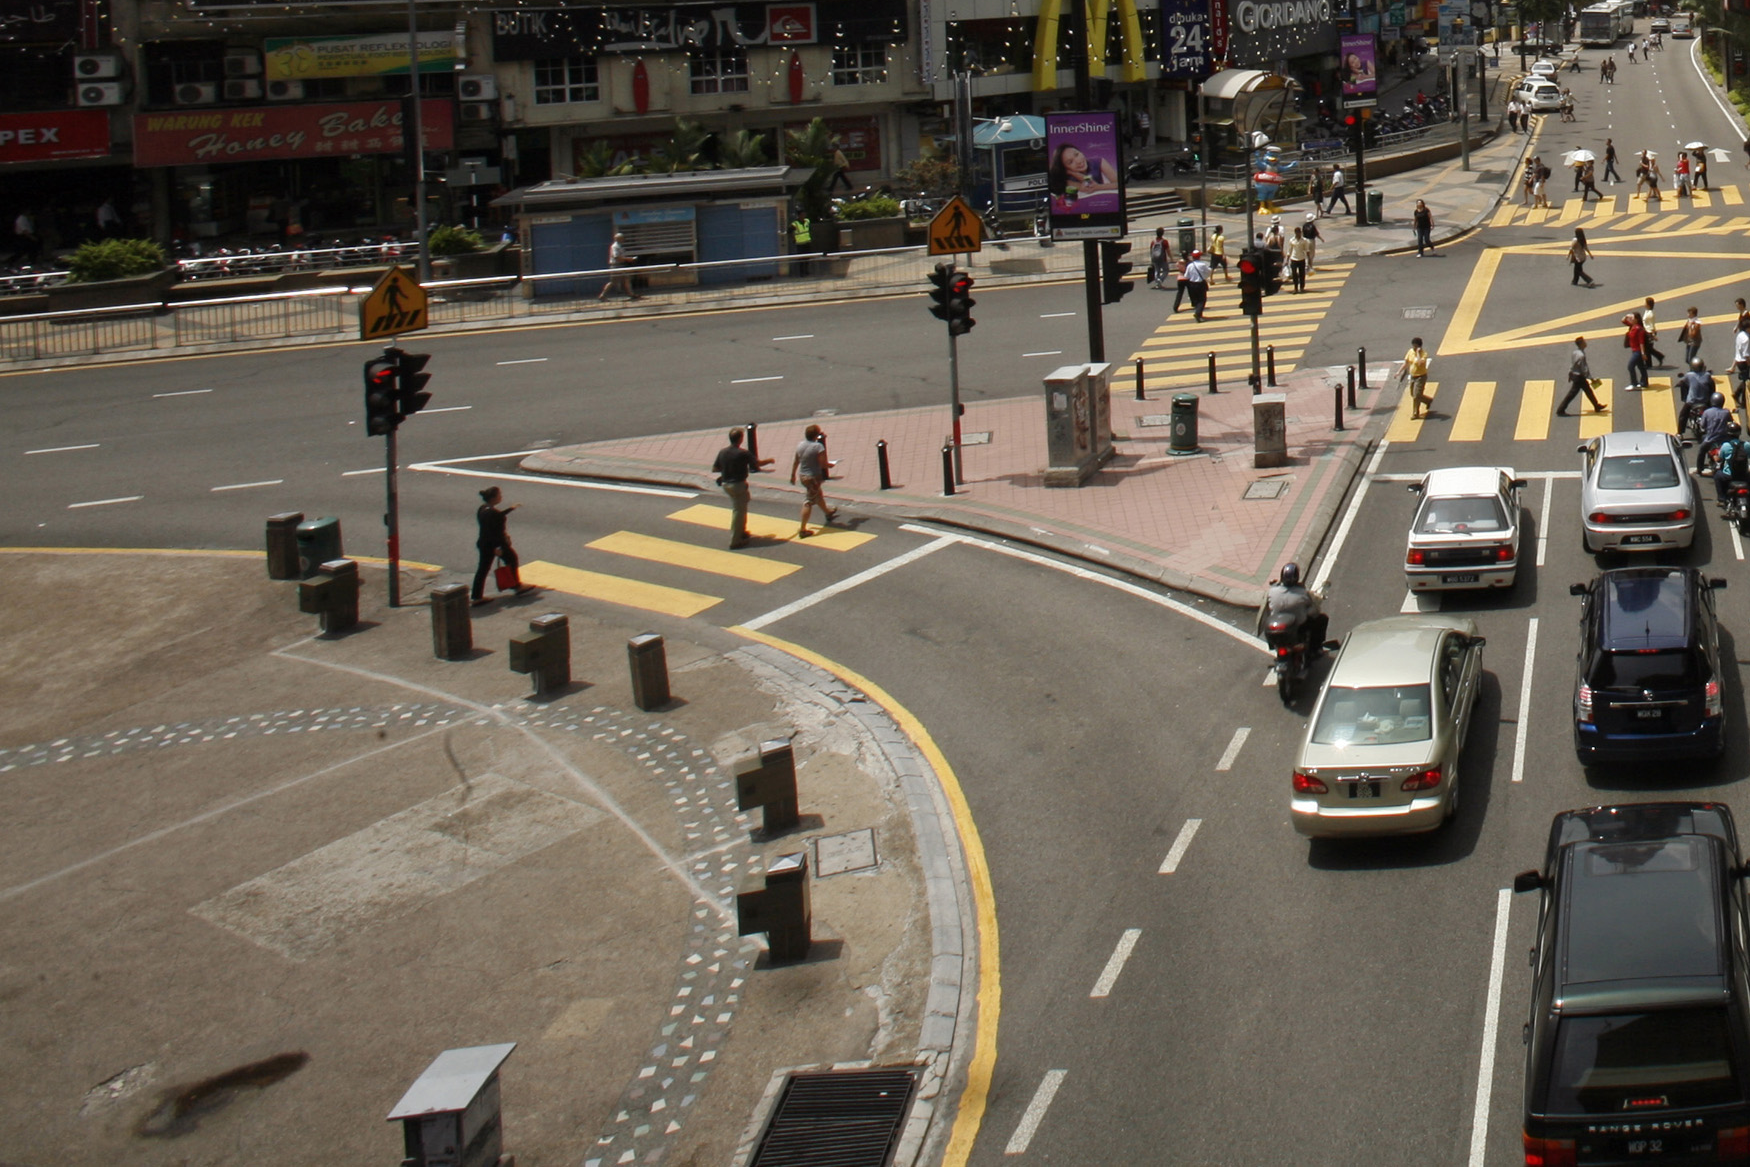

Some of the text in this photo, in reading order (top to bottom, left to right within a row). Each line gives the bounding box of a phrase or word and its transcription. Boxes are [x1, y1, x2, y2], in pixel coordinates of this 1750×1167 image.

[492, 11, 547, 35] BUTIK
[1236, 0, 1331, 33] GIORDANO
[1170, 24, 1203, 53] 24
[317, 44, 356, 54] PUSAT
[148, 113, 265, 131] WARUNG KEK
[1049, 123, 1111, 134] InnerShine
[188, 132, 306, 160] Honey
[1588, 1118, 1704, 1133] RANGE ROVER
[1650, 1139, 1662, 1152] 32
